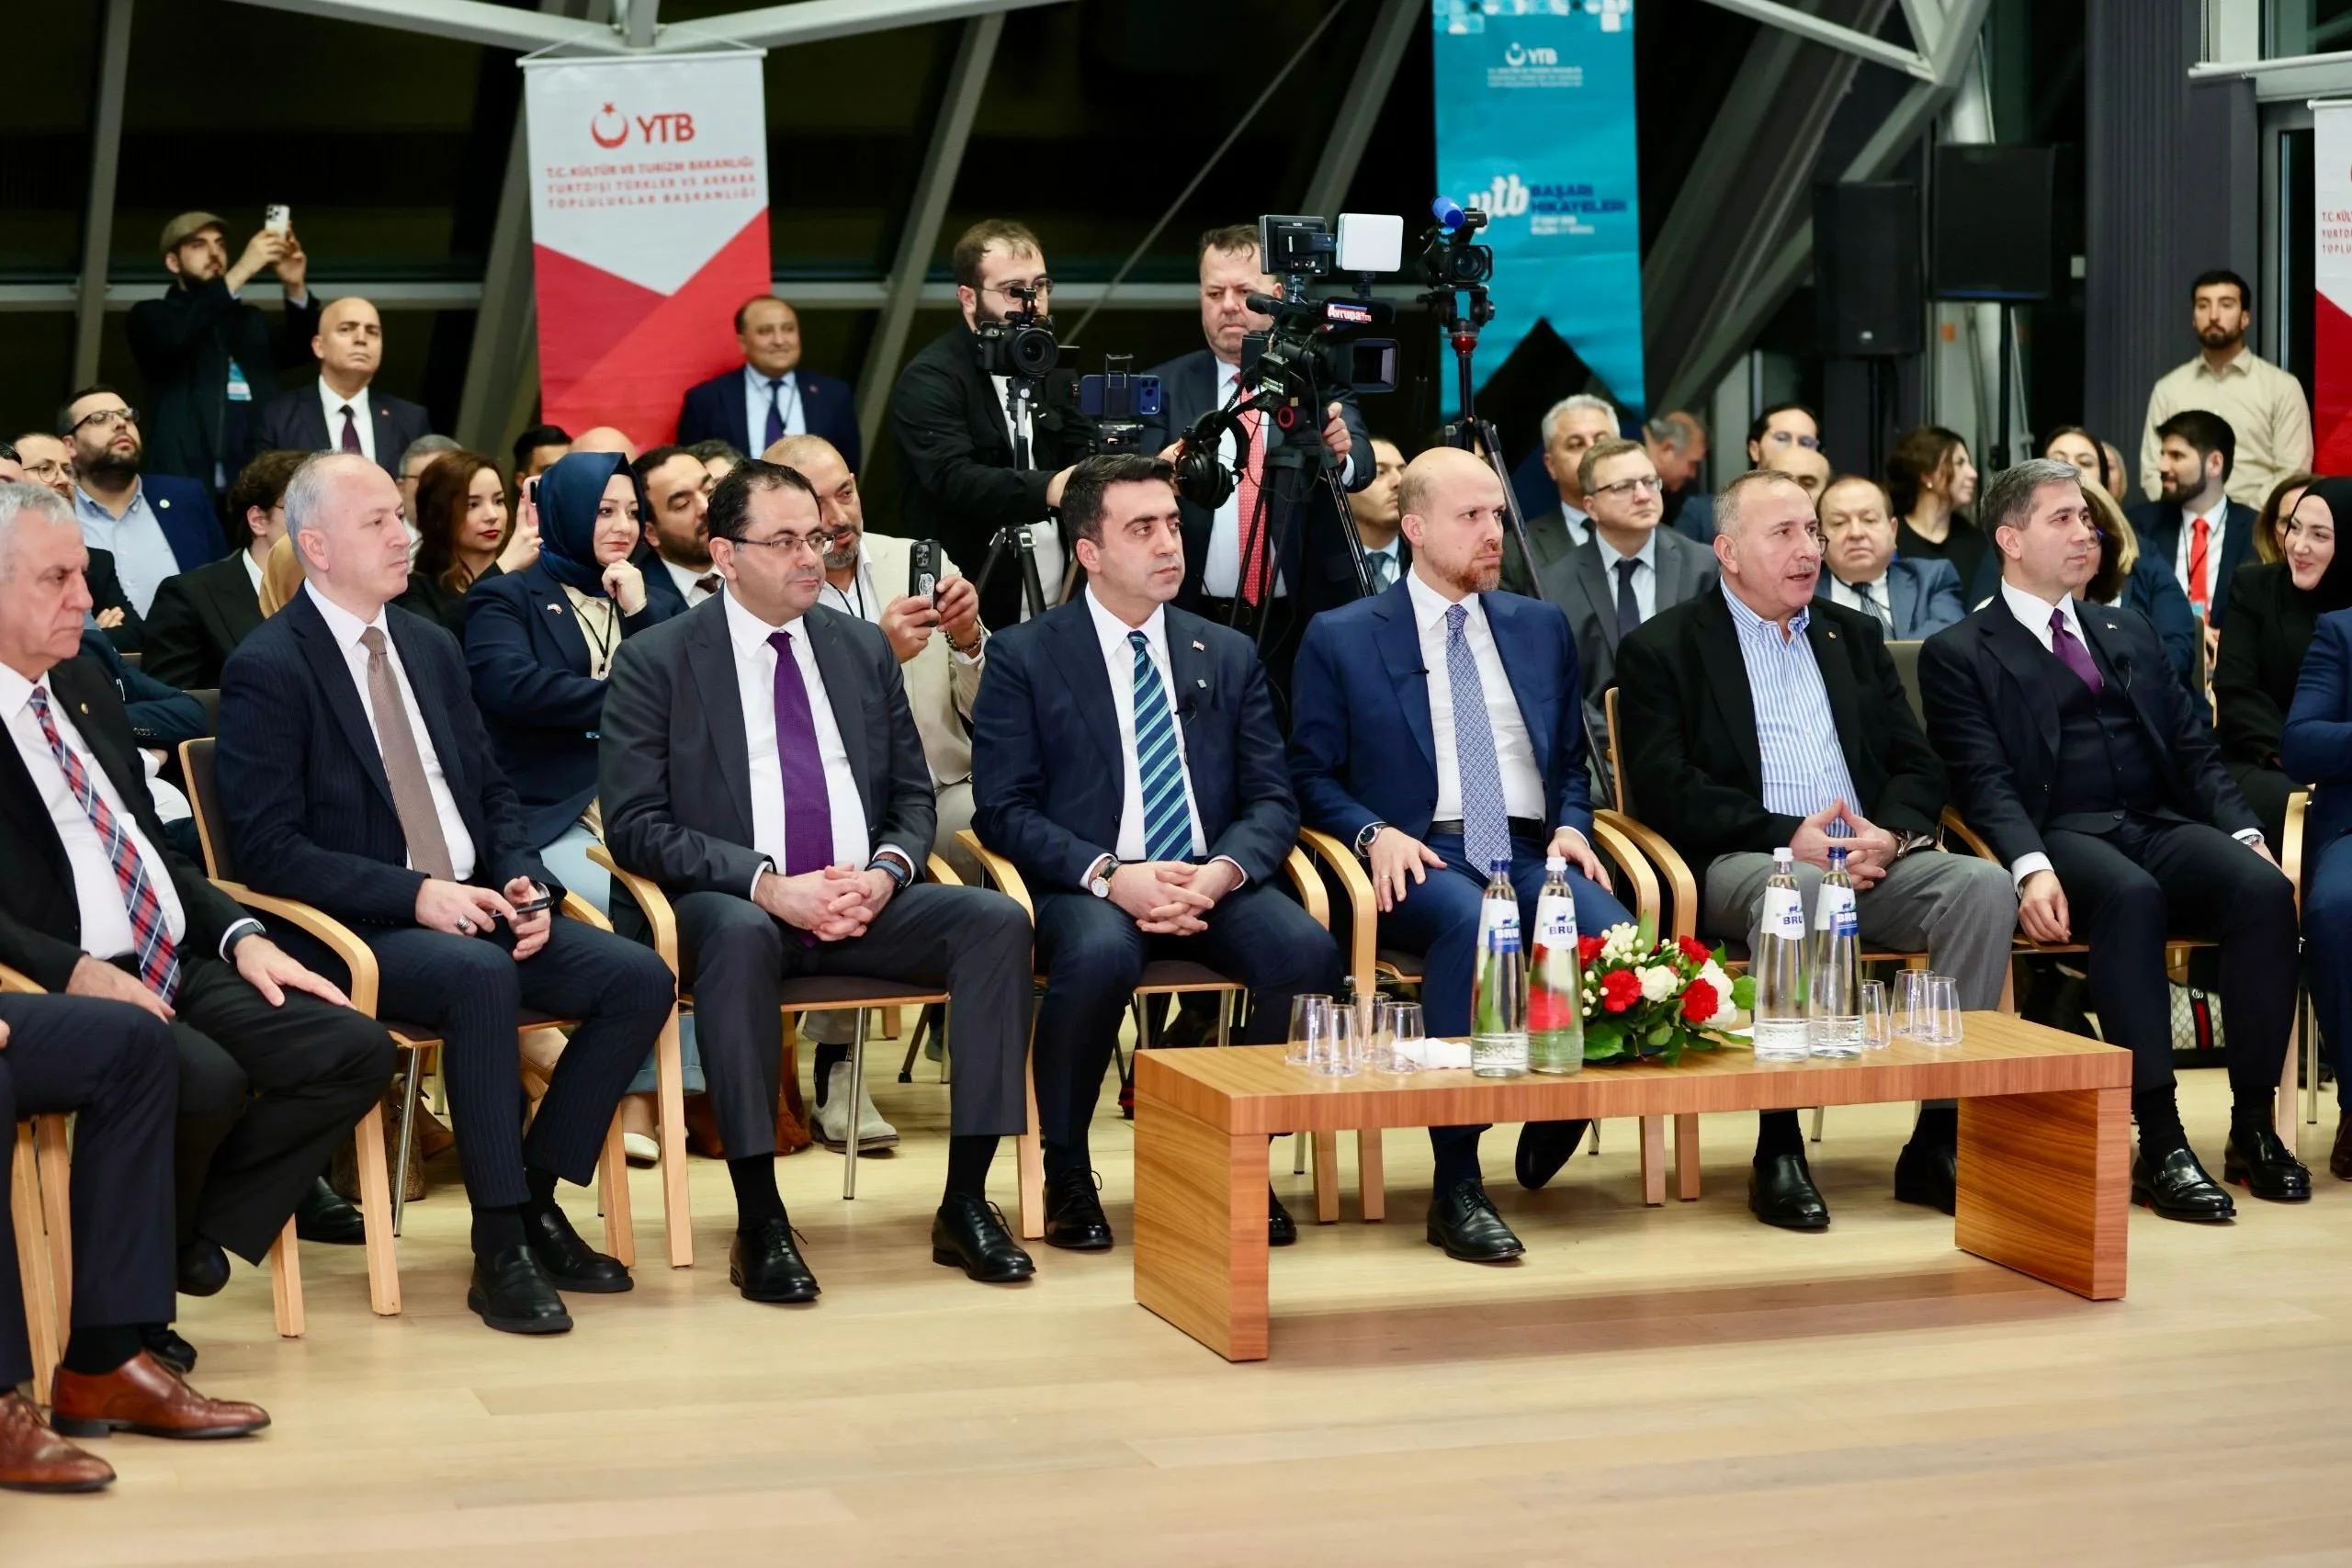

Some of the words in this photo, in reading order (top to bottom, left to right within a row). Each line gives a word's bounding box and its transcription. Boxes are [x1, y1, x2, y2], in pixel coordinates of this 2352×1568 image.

[1528, 48, 1558, 65] YTB
[636, 113, 695, 144] YTB
[621, 163, 635, 175] VE
[681, 175, 696, 188] VE
[1549, 926, 1573, 935] BRU
